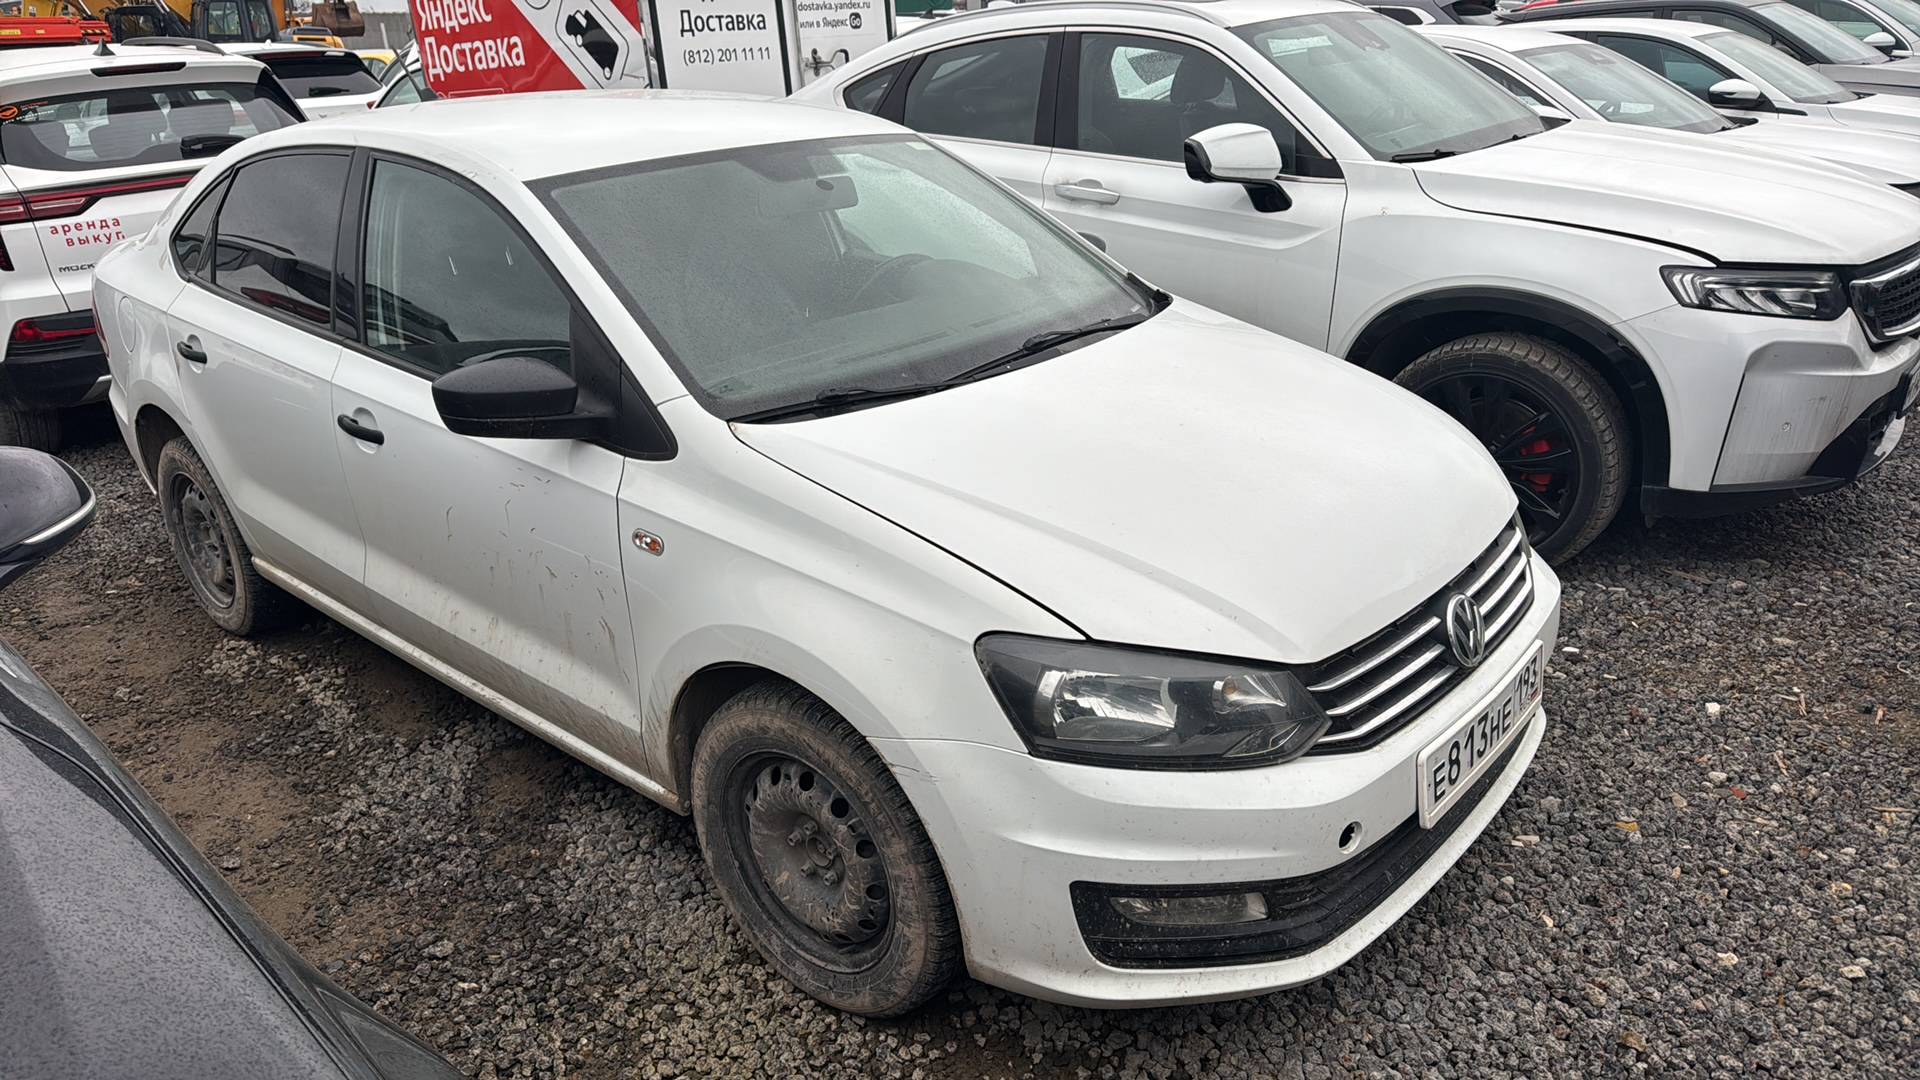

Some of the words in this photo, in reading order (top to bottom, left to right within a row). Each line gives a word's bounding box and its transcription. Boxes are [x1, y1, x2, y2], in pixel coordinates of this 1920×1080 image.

[798, 1, 871, 12] dostavka.yandex.ru
[416, 0, 492, 34] Яндекс
[680, 9, 766, 37] Доставка
[816, 20, 821, 28] в
[822, 17, 848, 29] Яндекс
[850, 13, 862, 28] Go
[424, 36, 525, 82] Доставка
[683, 49, 714, 66] (812)
[717, 48, 738, 62] 201
[741, 47, 754, 61] 11
[758, 46, 770, 60] 11
[49, 218, 121, 236] аренда
[58, 263, 95, 273] МОСК
[1515, 655, 1538, 705] 193
